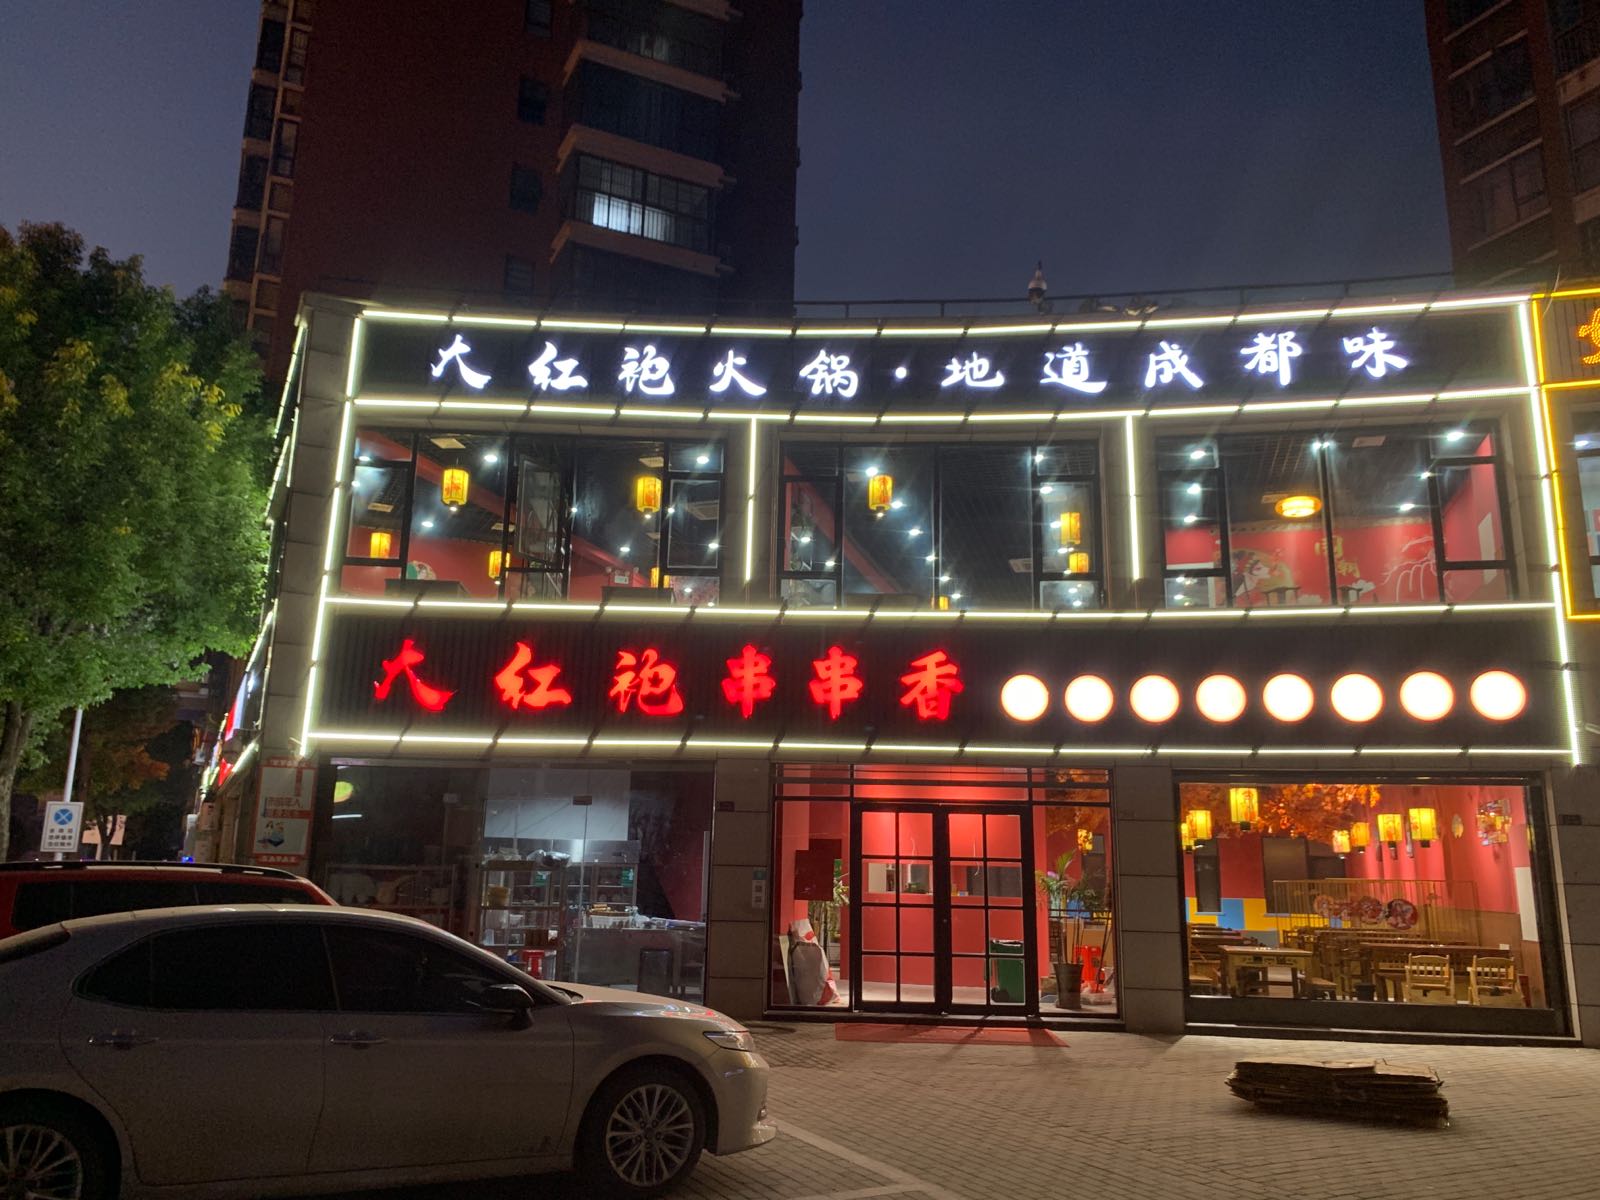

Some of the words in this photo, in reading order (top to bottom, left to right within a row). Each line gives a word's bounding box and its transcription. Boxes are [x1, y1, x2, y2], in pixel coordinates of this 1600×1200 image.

[374, 638, 964, 720] 大红袍串串香
